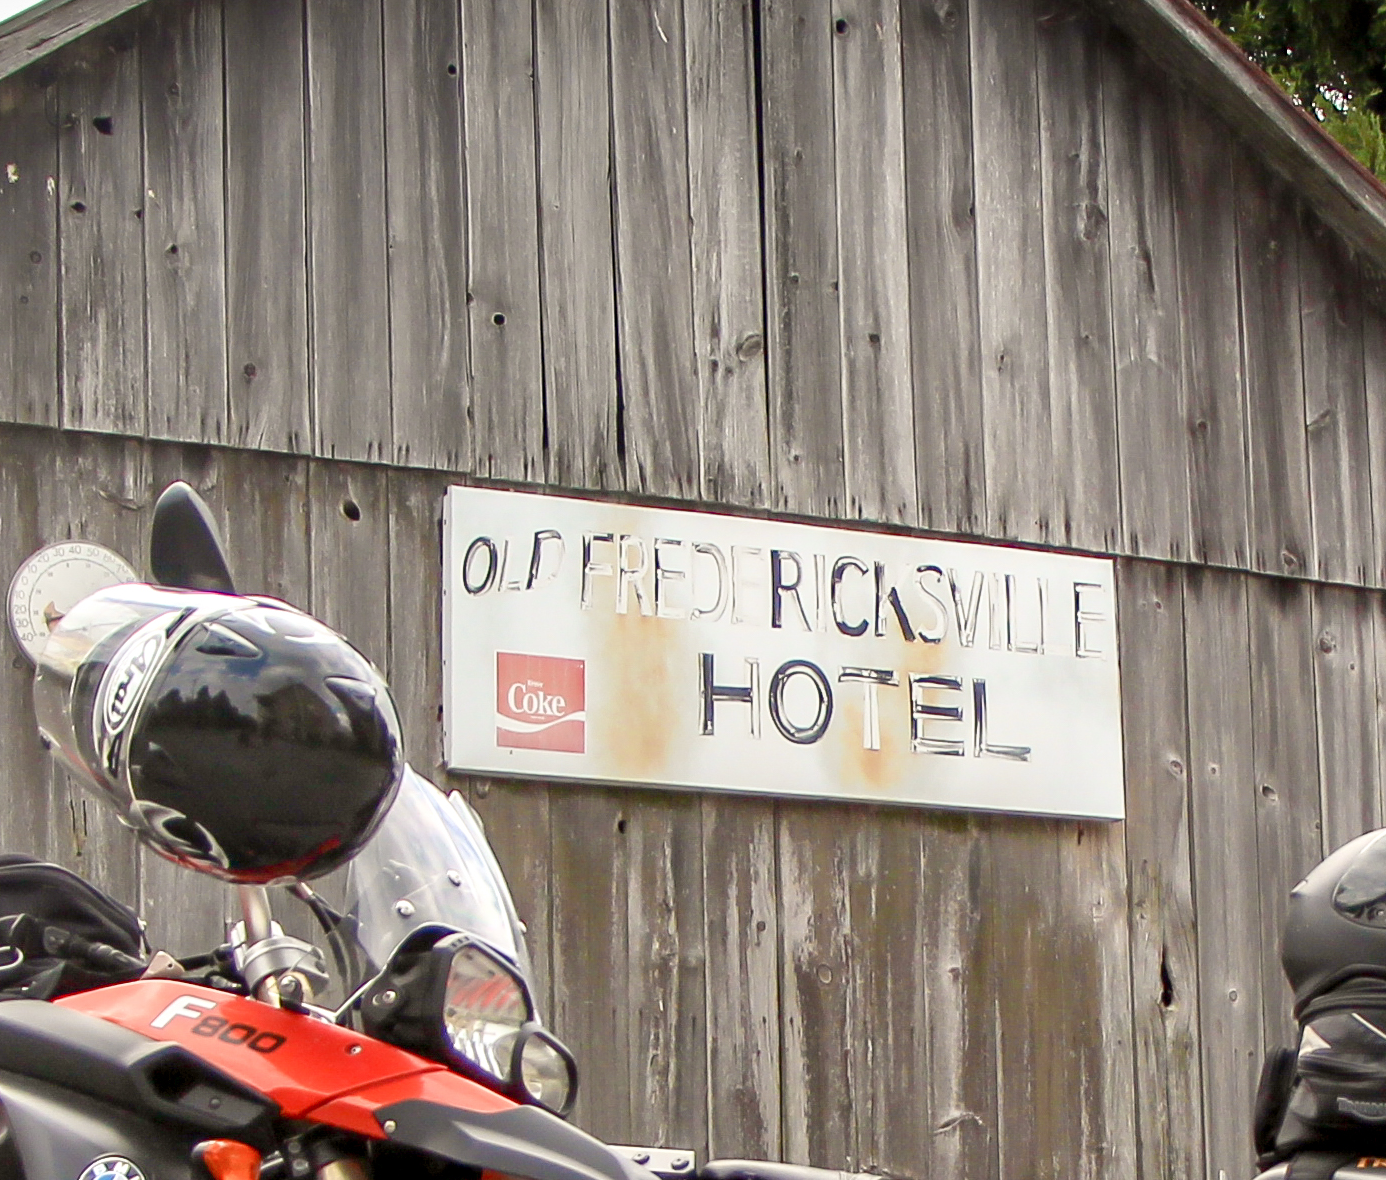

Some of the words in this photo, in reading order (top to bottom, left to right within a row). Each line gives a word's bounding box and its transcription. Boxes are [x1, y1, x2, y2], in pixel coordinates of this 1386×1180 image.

[69, 545, 81, 554] 40
[462, 529, 566, 596] OLD
[507, 682, 566, 717] Coke
[699, 652, 1032, 762] HOTEL
[150, 994, 287, 1053] F800
